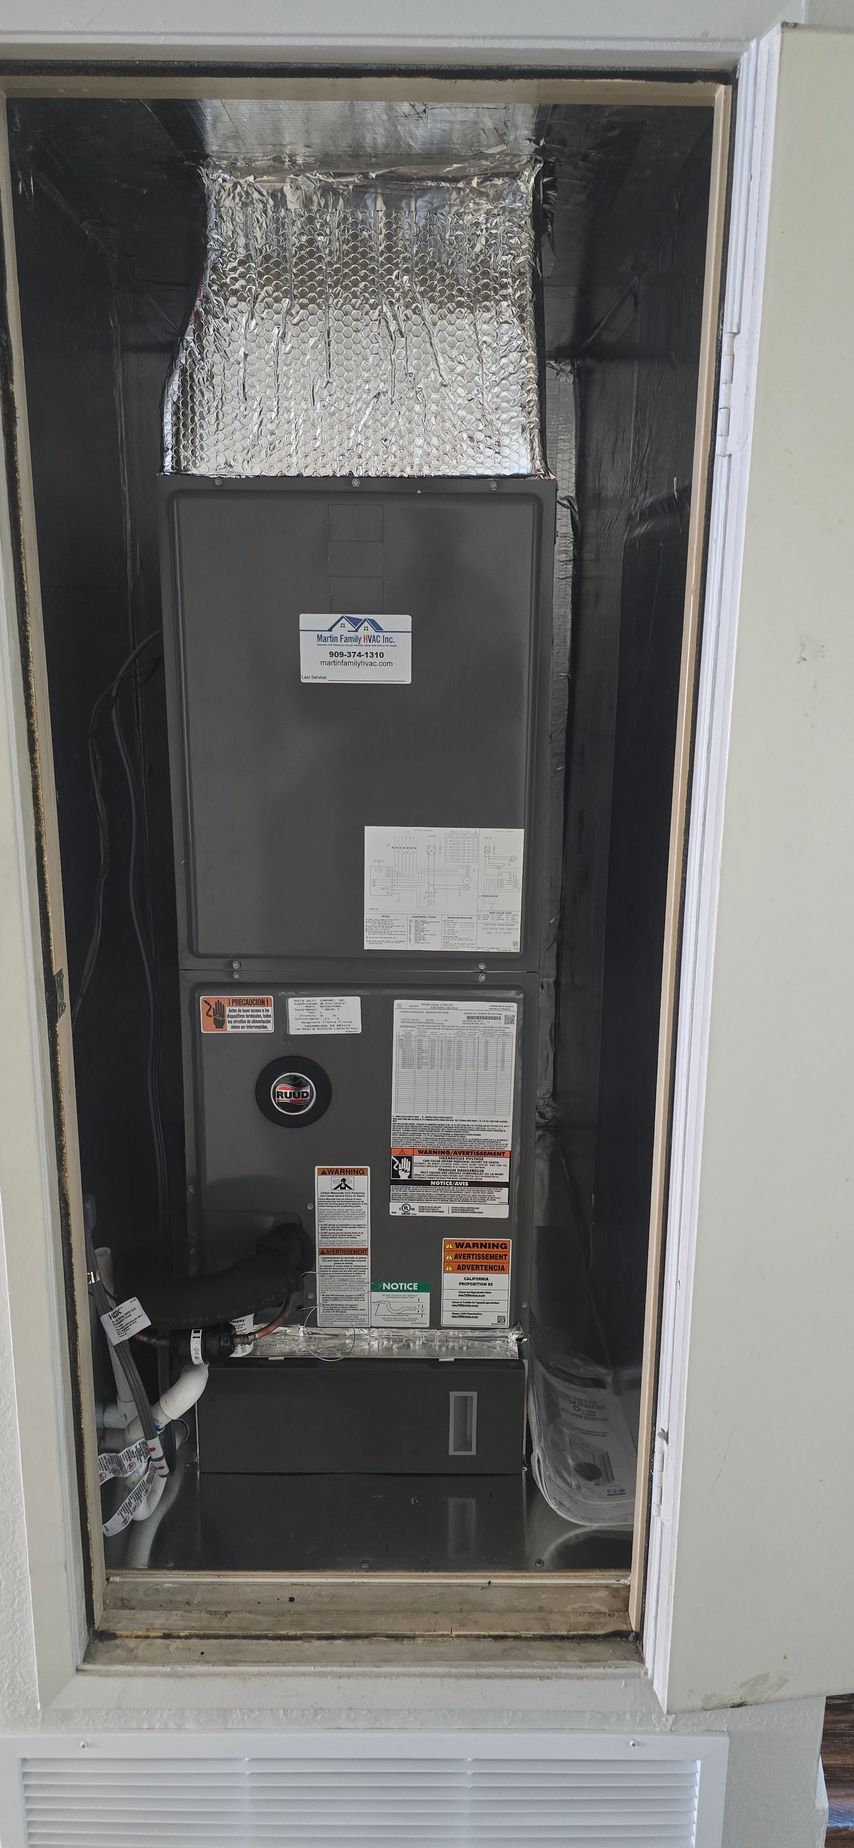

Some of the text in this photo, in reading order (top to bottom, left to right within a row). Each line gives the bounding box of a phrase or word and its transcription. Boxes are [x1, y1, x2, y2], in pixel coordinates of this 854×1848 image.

[316, 634, 395, 645] Martin Family HVAC Inc.
[320, 660, 394, 668] martinfamilyhvac.com
[108, 1308, 122, 1320] HDX
